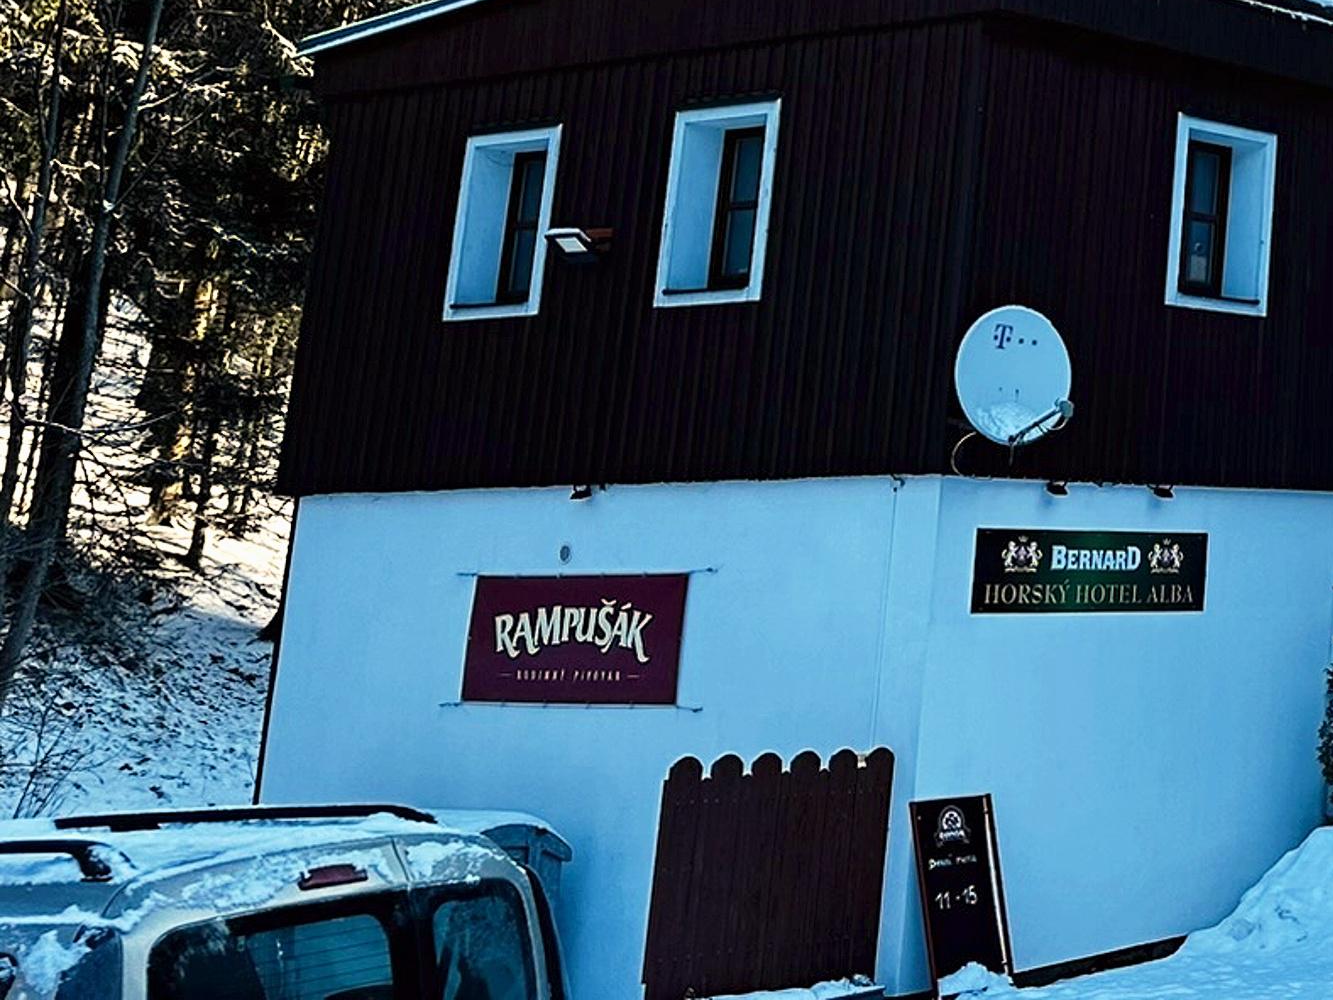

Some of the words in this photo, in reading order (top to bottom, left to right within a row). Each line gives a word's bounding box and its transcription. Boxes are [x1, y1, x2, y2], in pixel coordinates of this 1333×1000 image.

[1050, 545, 1142, 570] BERNARD
[984, 579, 1070, 604] HORSKÝ
[1075, 583, 1143, 604] HOTEL
[1146, 583, 1194, 604] ALBA
[494, 598, 653, 663] RAMPUŠÁK
